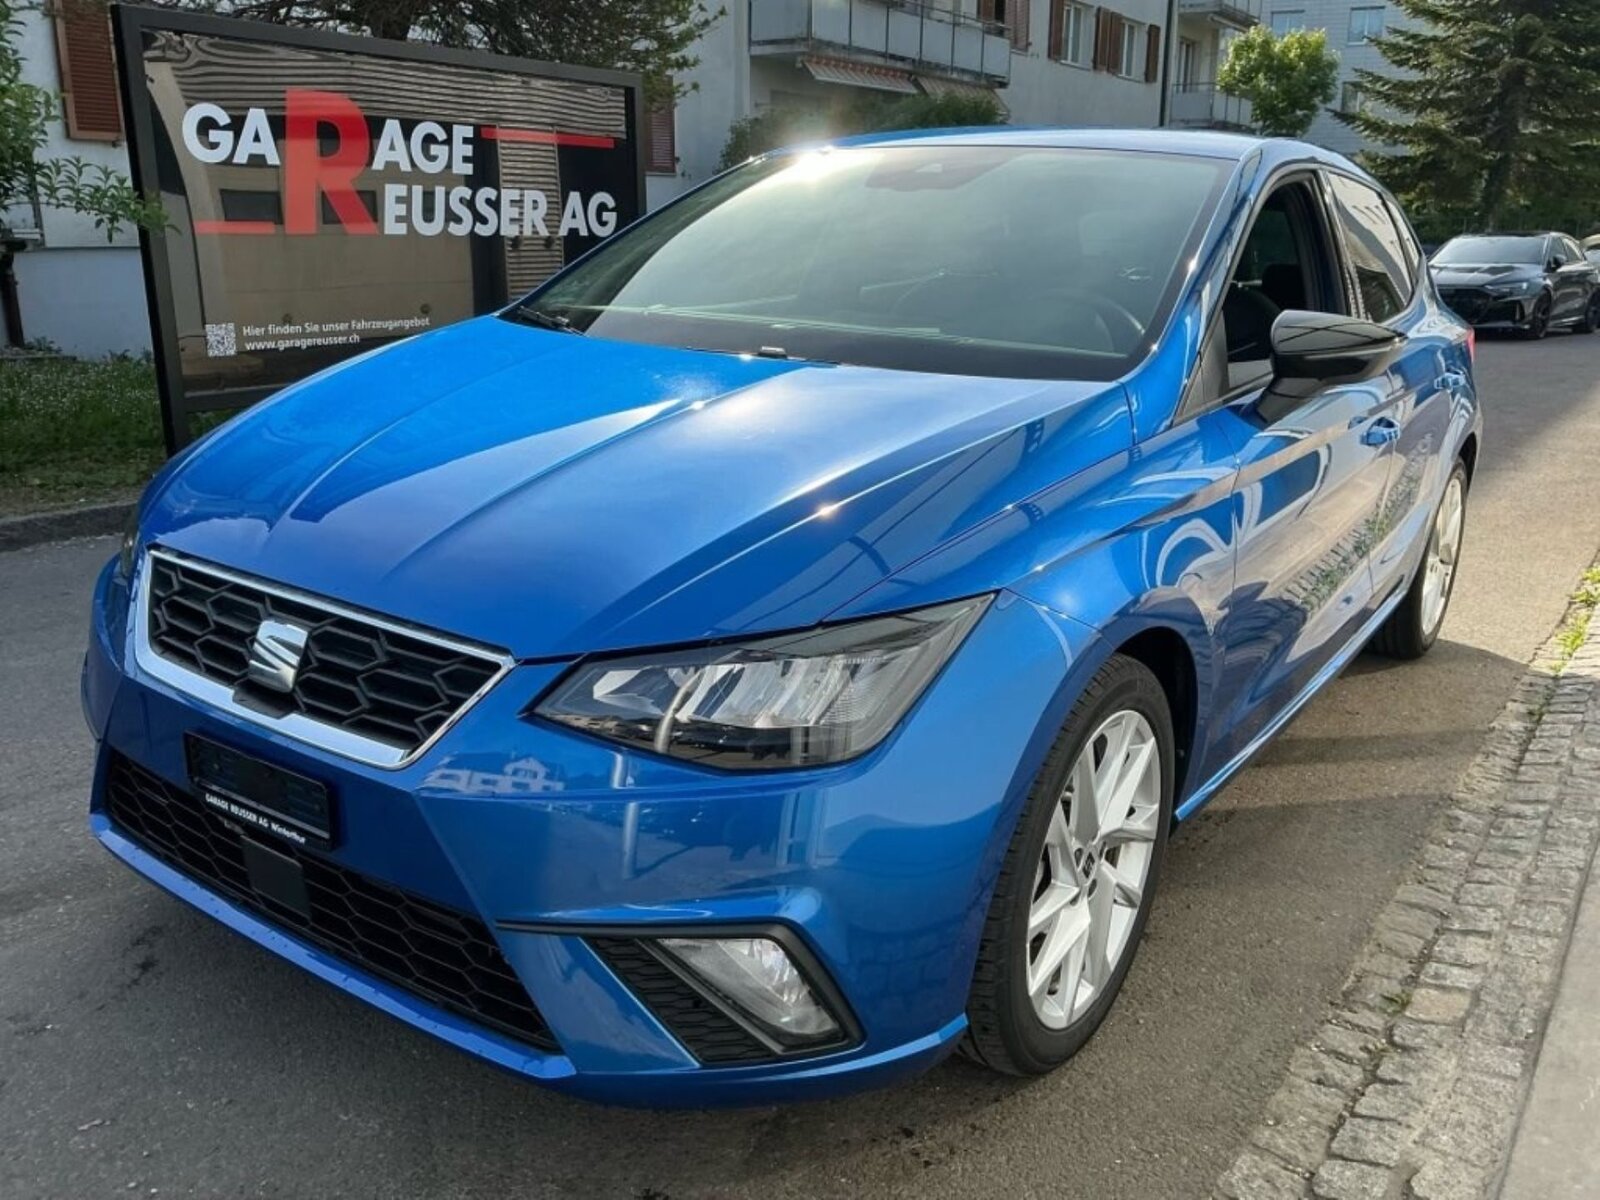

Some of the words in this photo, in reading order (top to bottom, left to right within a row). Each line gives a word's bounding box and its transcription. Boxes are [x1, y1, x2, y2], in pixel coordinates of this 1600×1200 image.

[182, 87, 474, 235] GARAGE
[558, 191, 618, 237] AG
[242, 325, 266, 337] Hier
[268, 323, 302, 335] finden
[304, 322, 319, 333] Sie
[322, 321, 349, 332] unser
[351, 316, 431, 331] Fahrzeugangebot
[244, 333, 360, 351] www.garagereusser.ch
